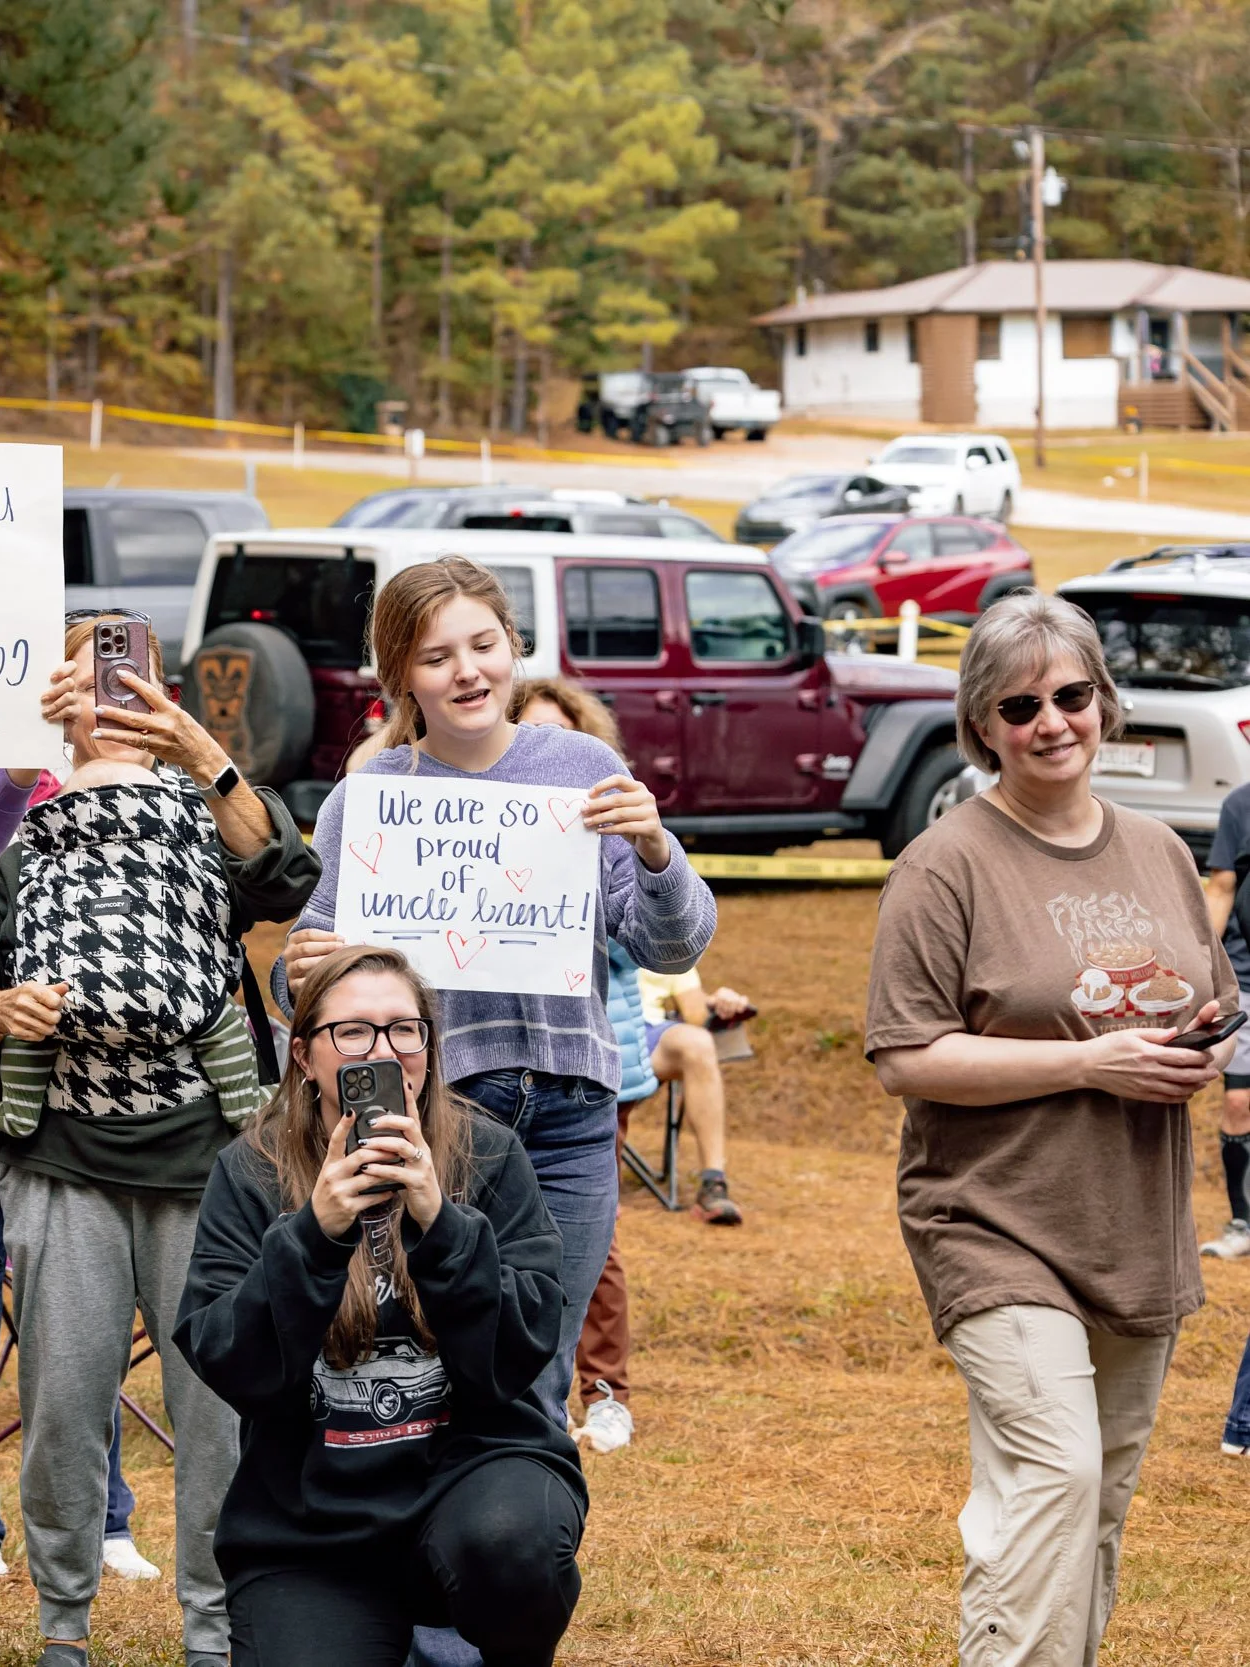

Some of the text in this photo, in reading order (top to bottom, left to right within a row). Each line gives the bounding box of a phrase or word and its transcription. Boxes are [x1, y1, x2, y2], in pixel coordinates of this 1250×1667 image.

[379, 790, 422, 826] We
[435, 798, 484, 825] are
[416, 832, 501, 867] proud
[441, 865, 475, 893] of
[361, 887, 590, 931] uncle brent!
